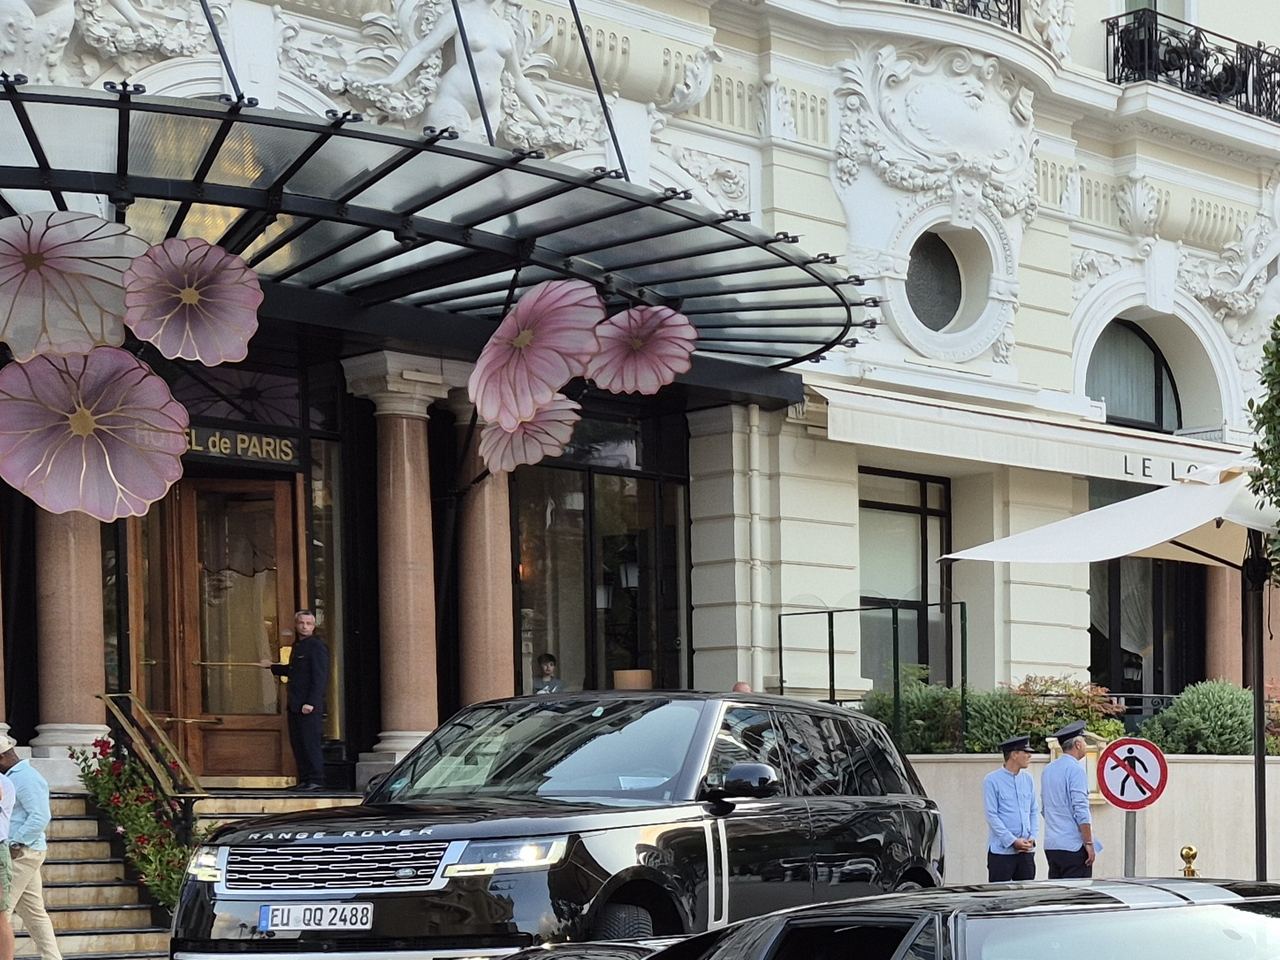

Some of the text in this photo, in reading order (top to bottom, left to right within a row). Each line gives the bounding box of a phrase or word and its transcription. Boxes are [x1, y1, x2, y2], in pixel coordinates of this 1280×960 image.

[208, 431, 231, 454] de
[236, 434, 293, 461] PARIS
[1124, 454, 1153, 478] LE
[248, 828, 434, 840] RANGE ROVER
[271, 906, 370, 927] EU QQ 2488
